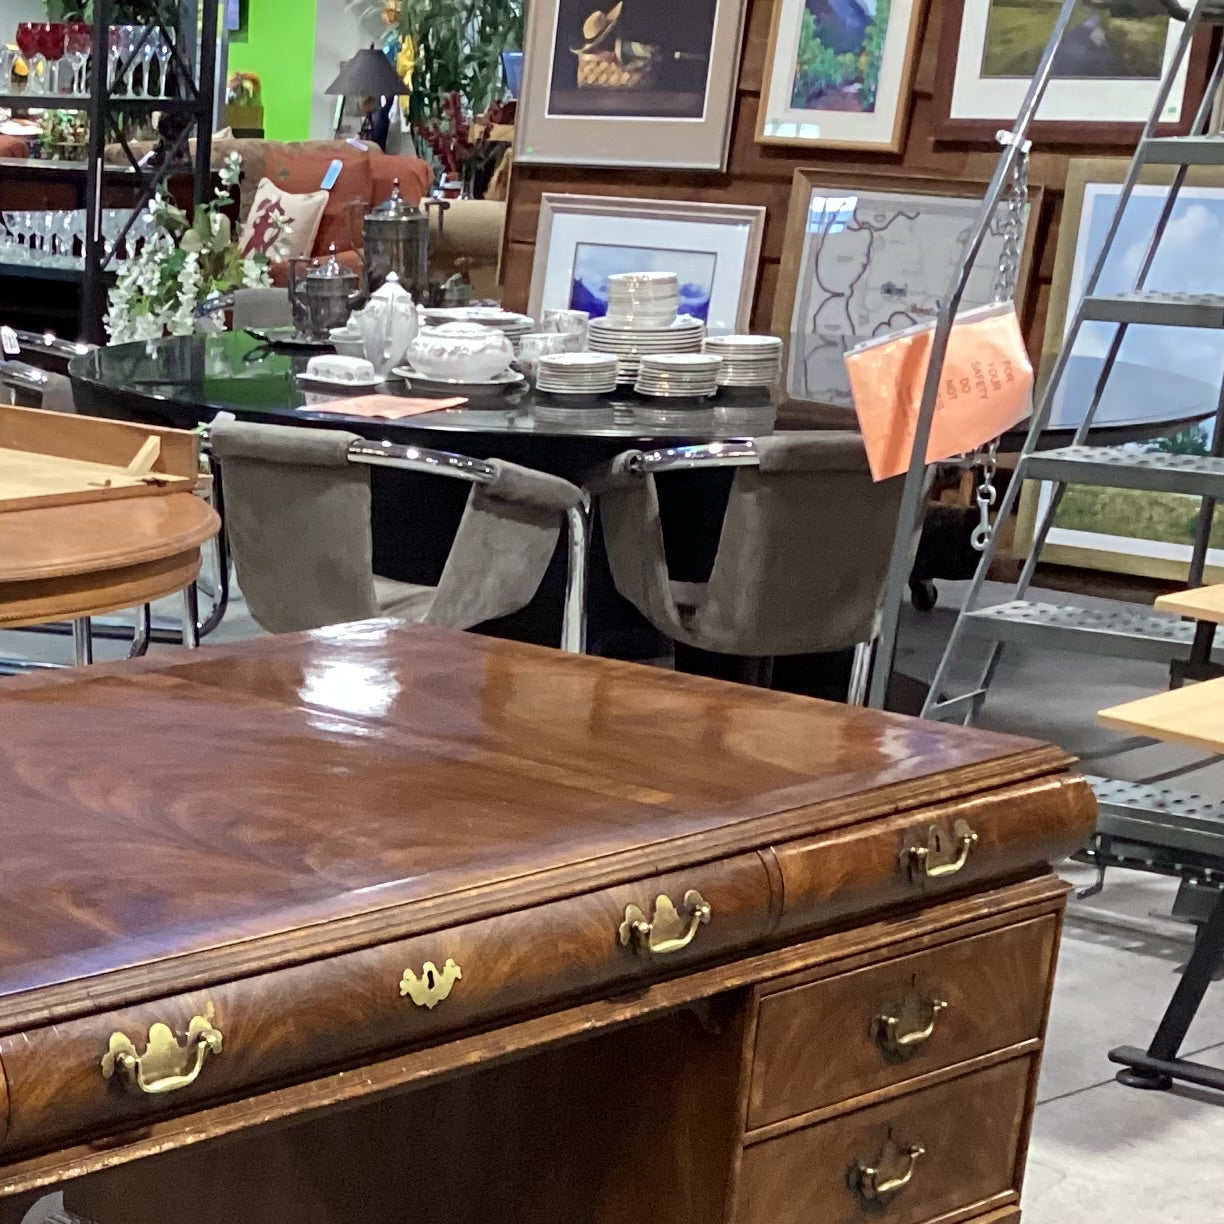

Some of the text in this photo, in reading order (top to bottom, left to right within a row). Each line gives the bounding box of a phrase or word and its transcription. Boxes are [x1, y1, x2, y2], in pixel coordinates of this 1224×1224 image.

[971, 361, 989, 399] SAFETY
[987, 361, 1001, 391] YOUR
[1003, 360, 1015, 383] FOR
[945, 379, 958, 400] NOT
[960, 378, 971, 394] DO
